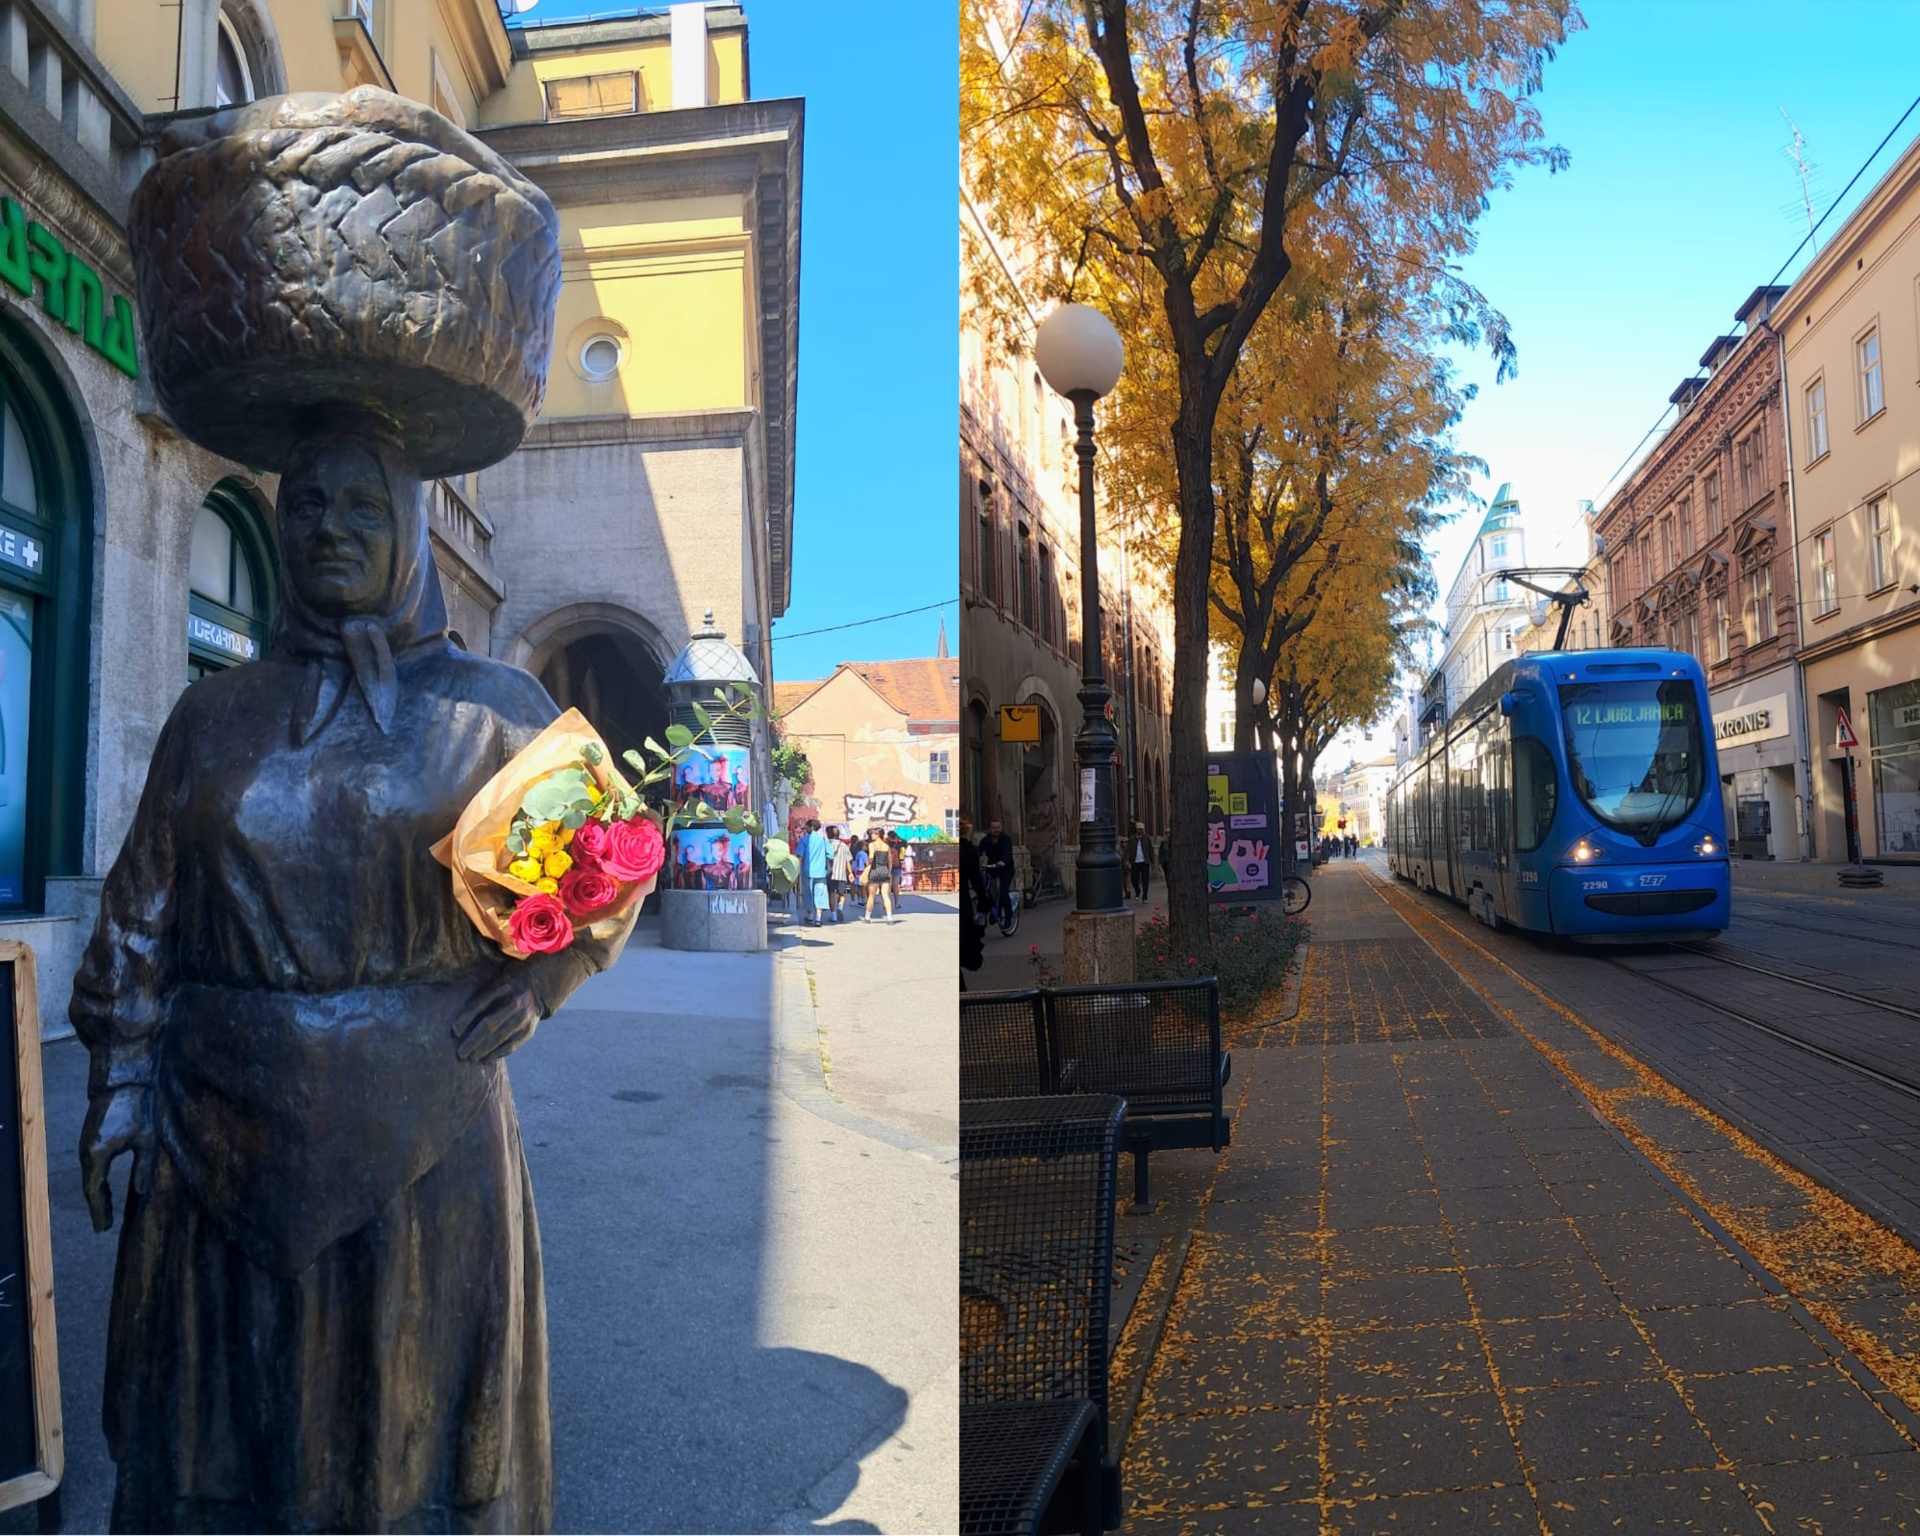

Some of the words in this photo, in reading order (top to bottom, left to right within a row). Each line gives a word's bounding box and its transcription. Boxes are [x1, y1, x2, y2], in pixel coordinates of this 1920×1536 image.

[1575, 705, 1591, 724] 12
[1595, 704, 1684, 724] LJUBLJANICA
[1522, 871, 1538, 883] 2290
[1640, 875, 1667, 887] ZET
[1582, 881, 1608, 890] 2290
